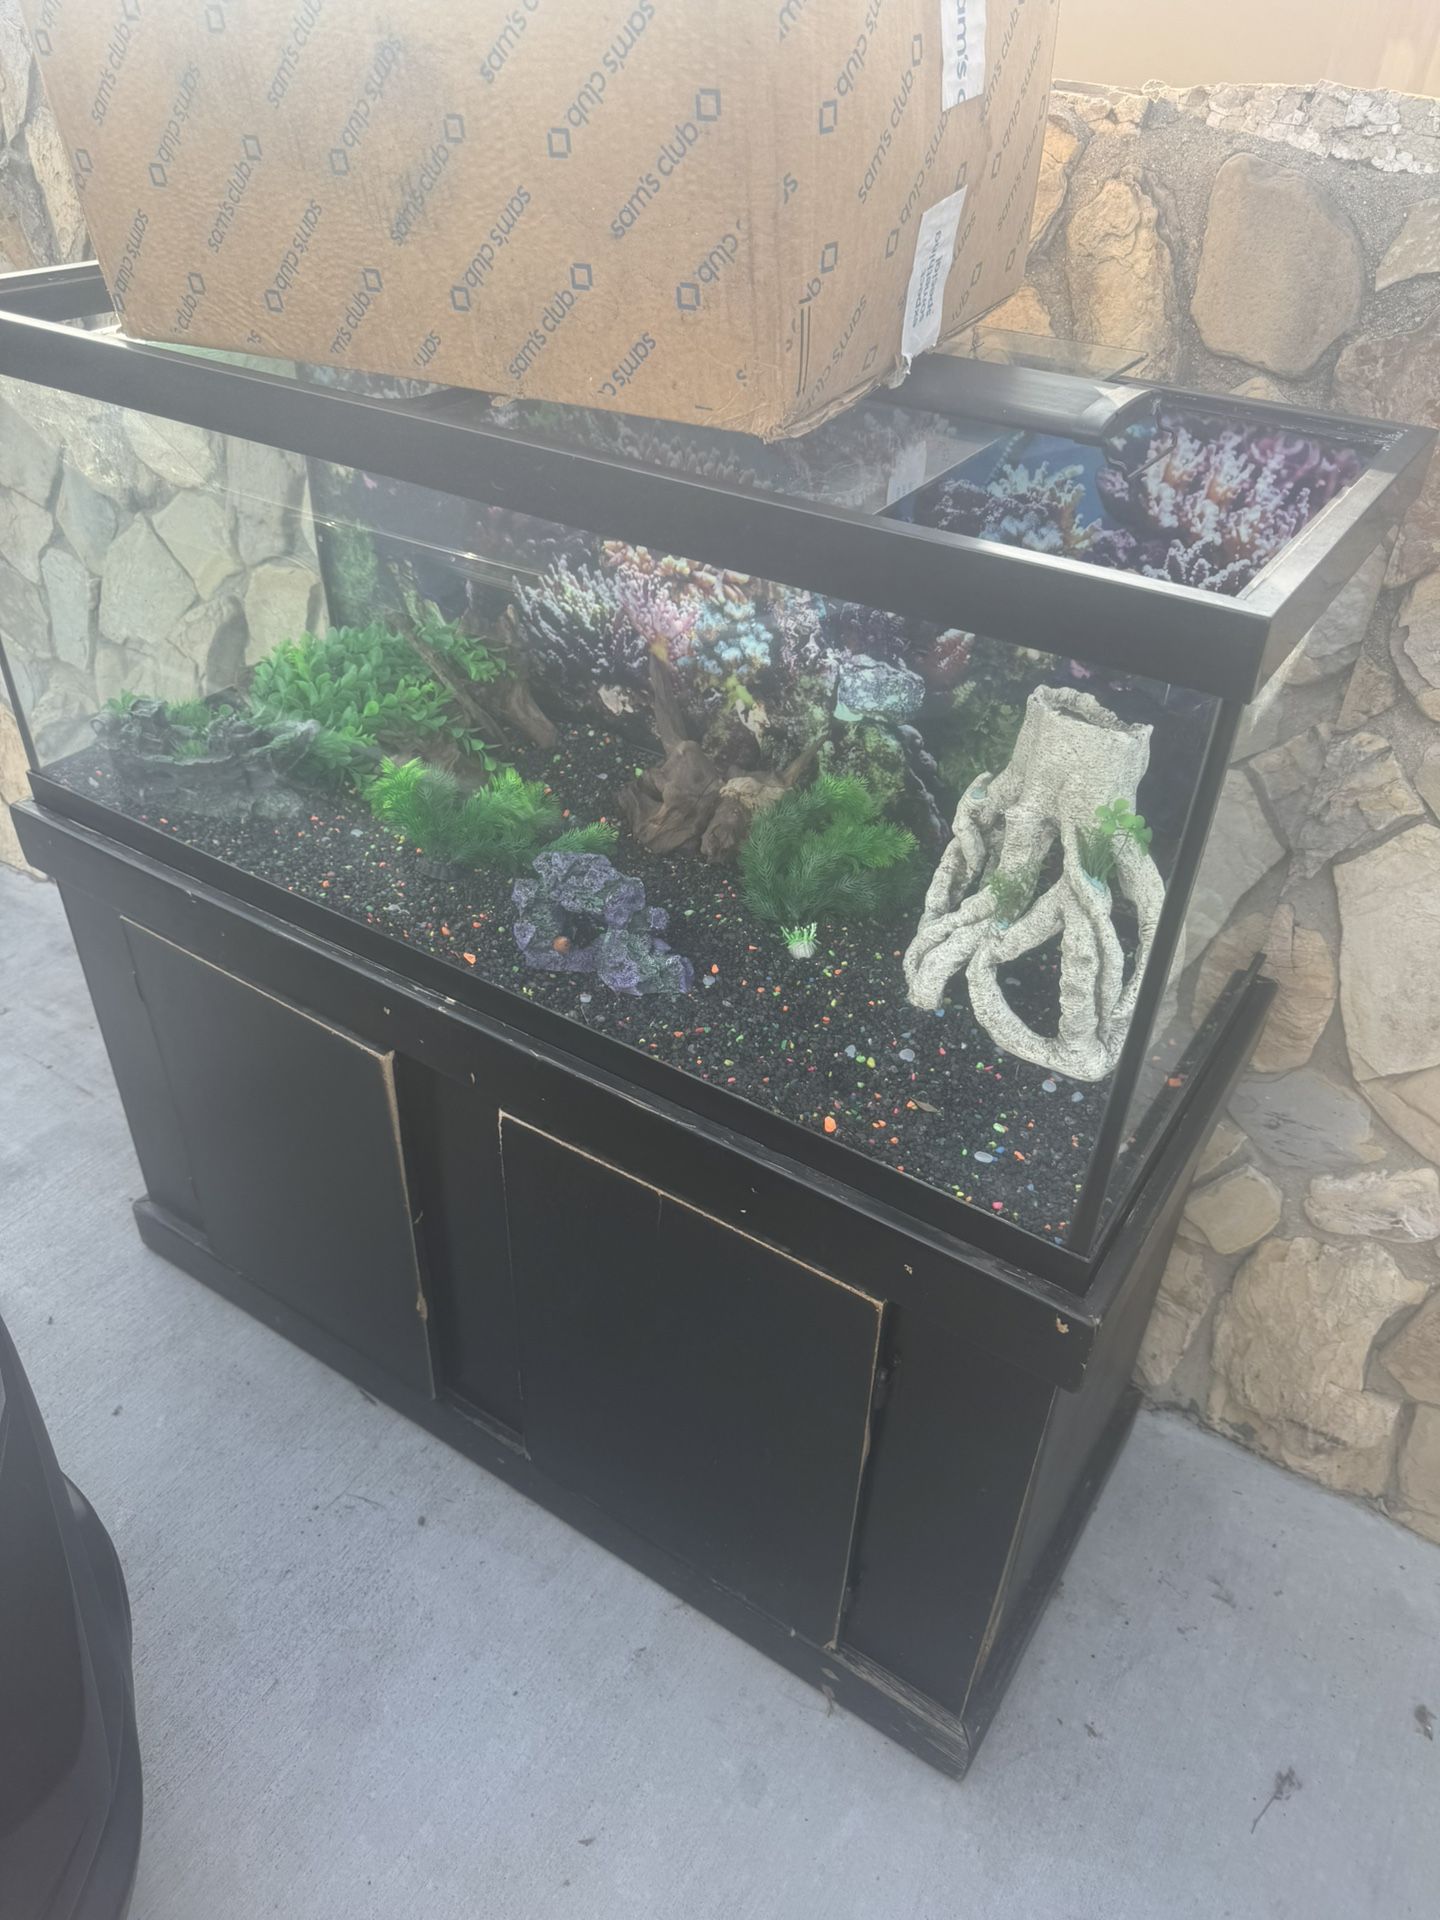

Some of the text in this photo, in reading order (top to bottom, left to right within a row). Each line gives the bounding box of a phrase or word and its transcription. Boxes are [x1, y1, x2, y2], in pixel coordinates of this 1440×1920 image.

[90, 23, 130, 127] sam's club
[480, 13, 528, 84] sam's
[566, 0, 655, 128] sam's club
[835, 34, 867, 96] club
[956, 0, 969, 80] am's
[1002, 8, 1020, 60] club
[156, 62, 199, 164] sam's club
[267, 45, 299, 109] sam's
[341, 31, 402, 149] sam's club
[1001, 34, 1041, 150] sam's club
[858, 70, 914, 204] sam's club
[207, 161, 252, 253] sam's club
[391, 144, 448, 247] sam's club
[611, 122, 698, 240] sam's club
[900, 170, 925, 224] club
[998, 172, 1022, 231] sam's
[114, 208, 149, 293] sam's club
[275, 199, 322, 290] sam's club
[463, 185, 531, 288] sam's club
[699, 232, 739, 283] club
[919, 230, 942, 323] something
[177, 294, 198, 331] club
[345, 291, 371, 331] club
[926, 255, 943, 318] special
[508, 289, 575, 380] sam's club
[611, 332, 657, 387] sam's
[832, 294, 867, 365] sam's
